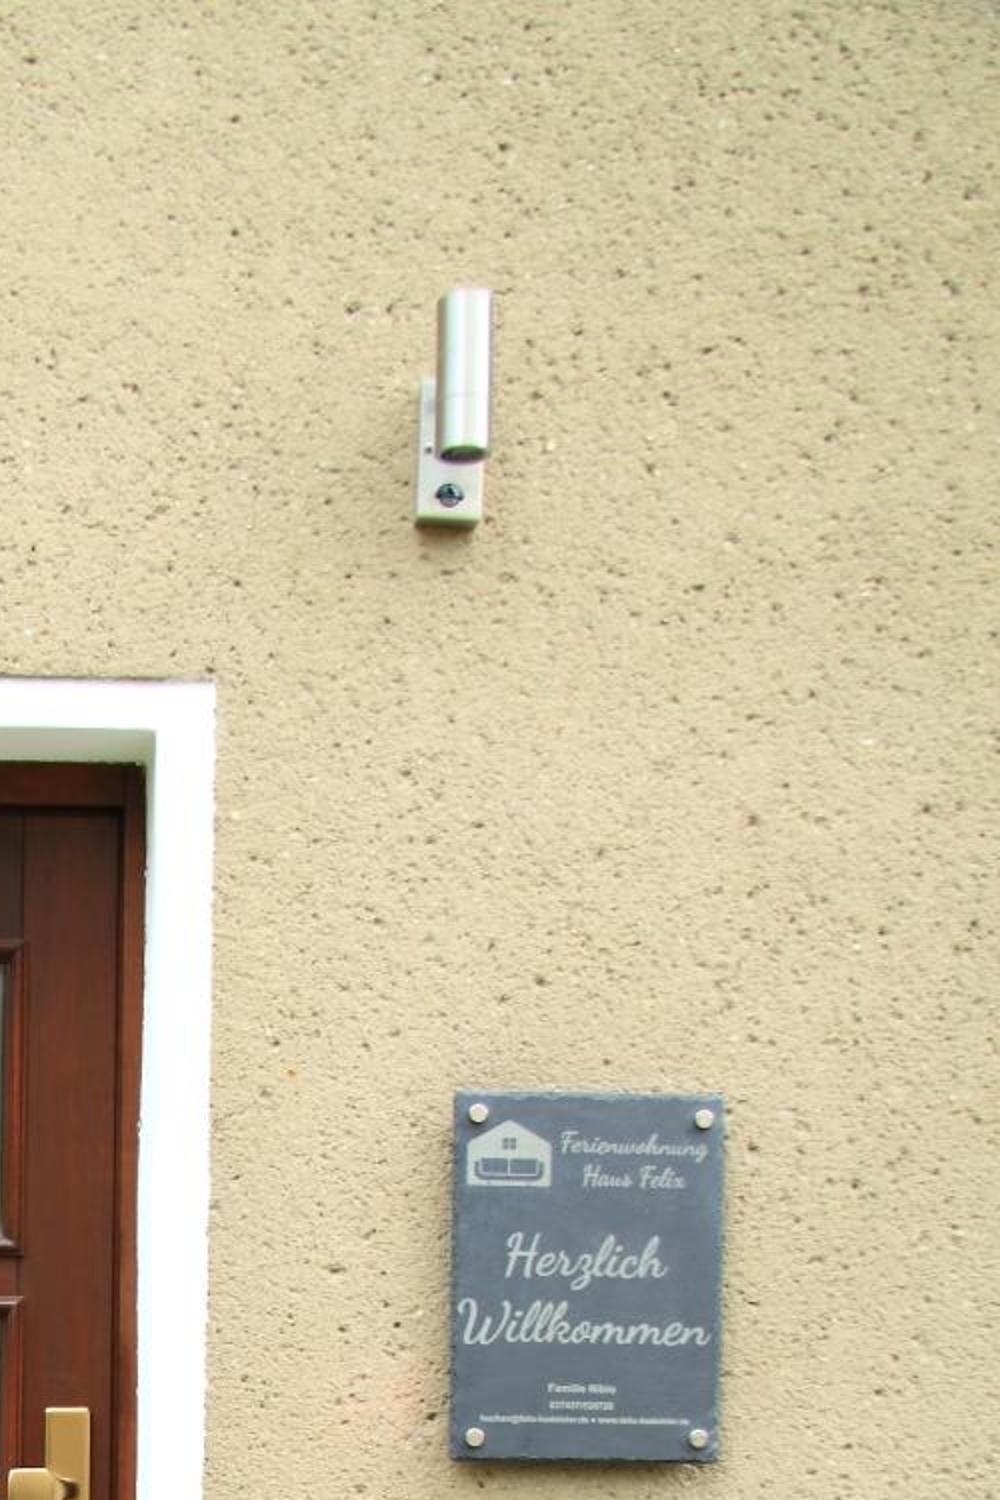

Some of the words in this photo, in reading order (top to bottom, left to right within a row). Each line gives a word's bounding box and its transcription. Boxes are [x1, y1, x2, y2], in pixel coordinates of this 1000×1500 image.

[560, 1131, 707, 1163] Ferienwohnung
[583, 1164, 633, 1188] Haus
[639, 1165, 687, 1189] Felix
[505, 1232, 668, 1290] Herzlich
[457, 1298, 710, 1346] Willkommen
